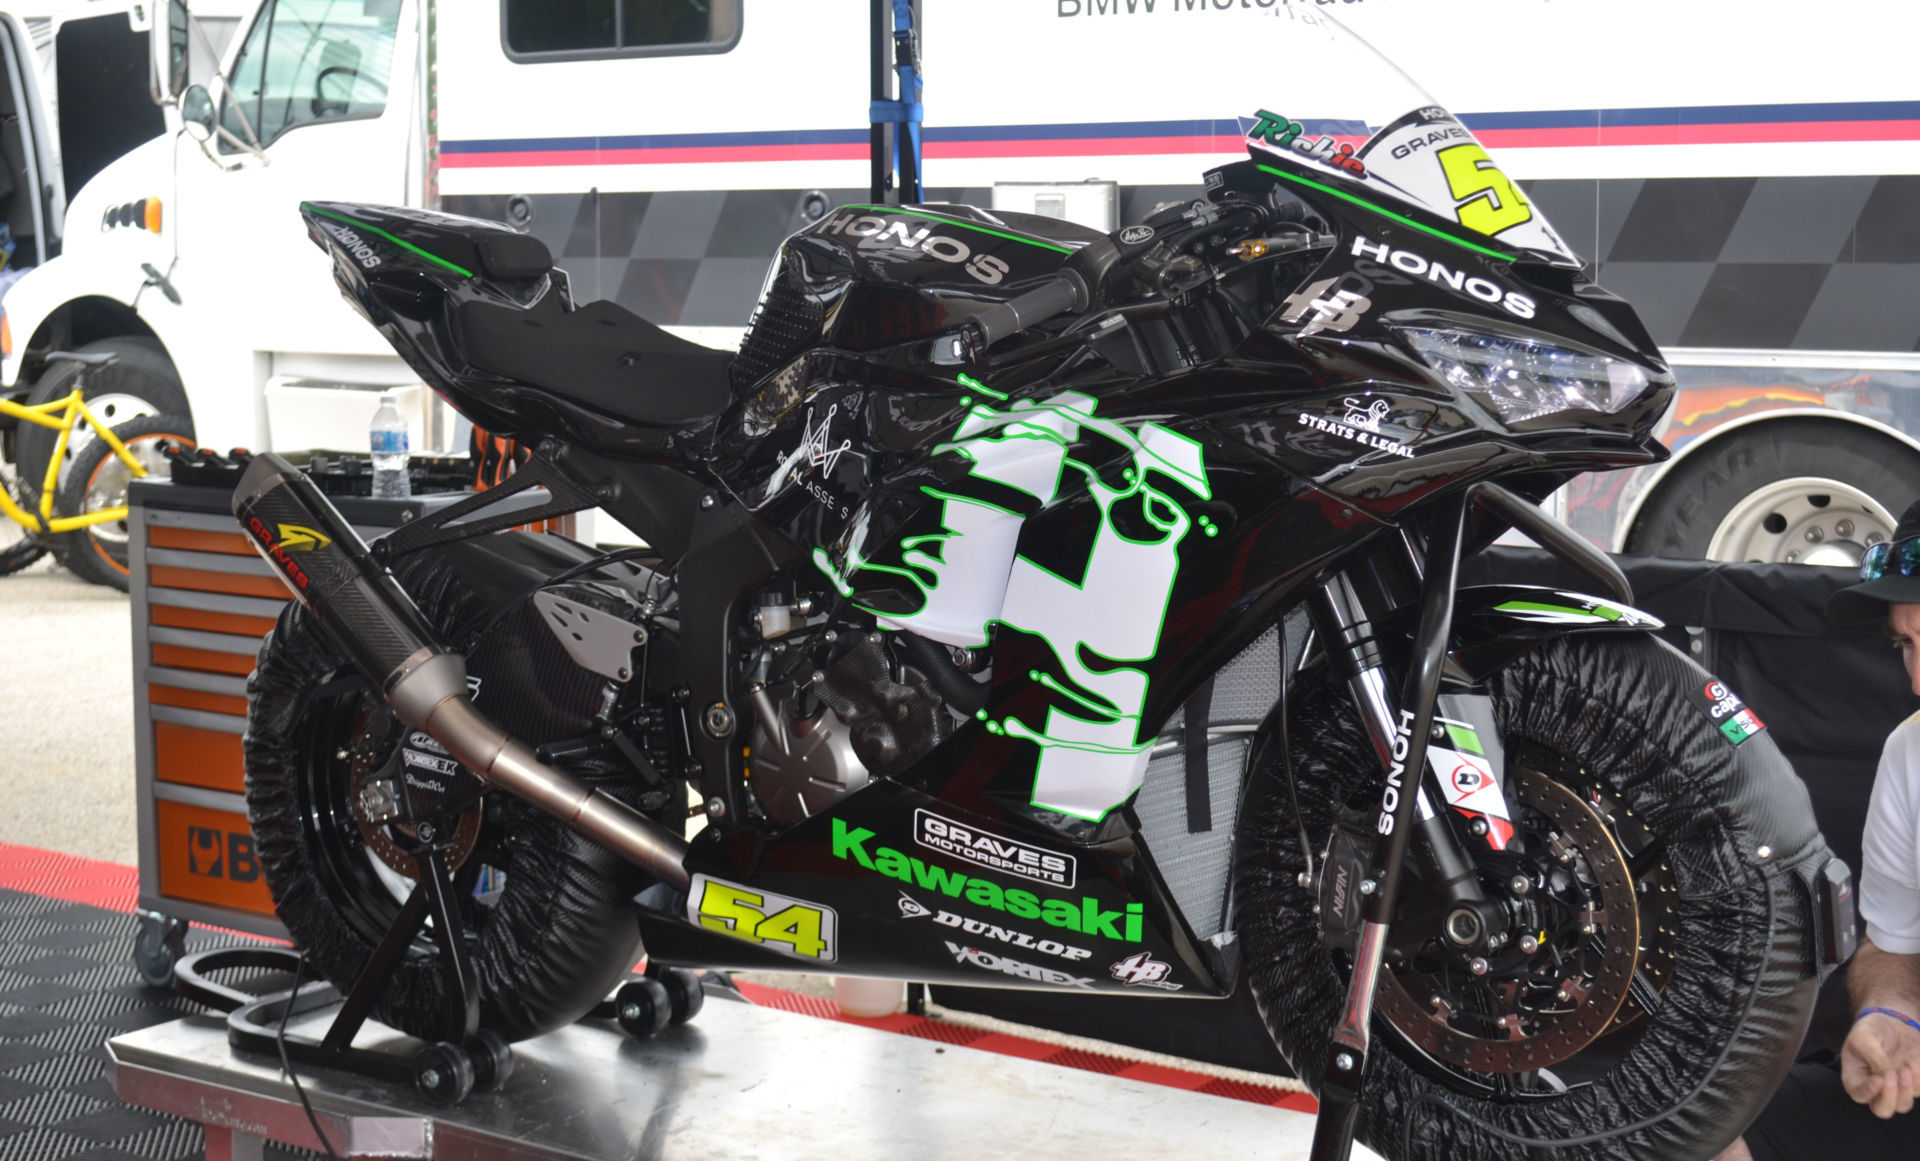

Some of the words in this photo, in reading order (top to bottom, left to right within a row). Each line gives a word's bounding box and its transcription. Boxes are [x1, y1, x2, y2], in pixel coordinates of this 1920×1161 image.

[1248, 109, 1367, 180] Richie
[333, 226, 382, 268] HONOS
[817, 213, 1010, 285] HONOS
[1351, 236, 1536, 320] HONOS
[1298, 412, 1356, 441] STRATS
[1356, 432, 1368, 444] &
[1370, 436, 1415, 459] LEGAL
[776, 450, 803, 486] ROAL
[806, 481, 849, 520] ASSES
[250, 516, 309, 590] GRAVES
[1377, 709, 1414, 837] HONOS
[924, 817, 1067, 872] GRAVES
[924, 833, 1066, 884] MOTORSPORTS
[832, 817, 1144, 943] Kawasaki
[699, 879, 828, 959] 54
[932, 910, 1092, 962] DUNLOP
[945, 940, 1097, 991] VORTEX
